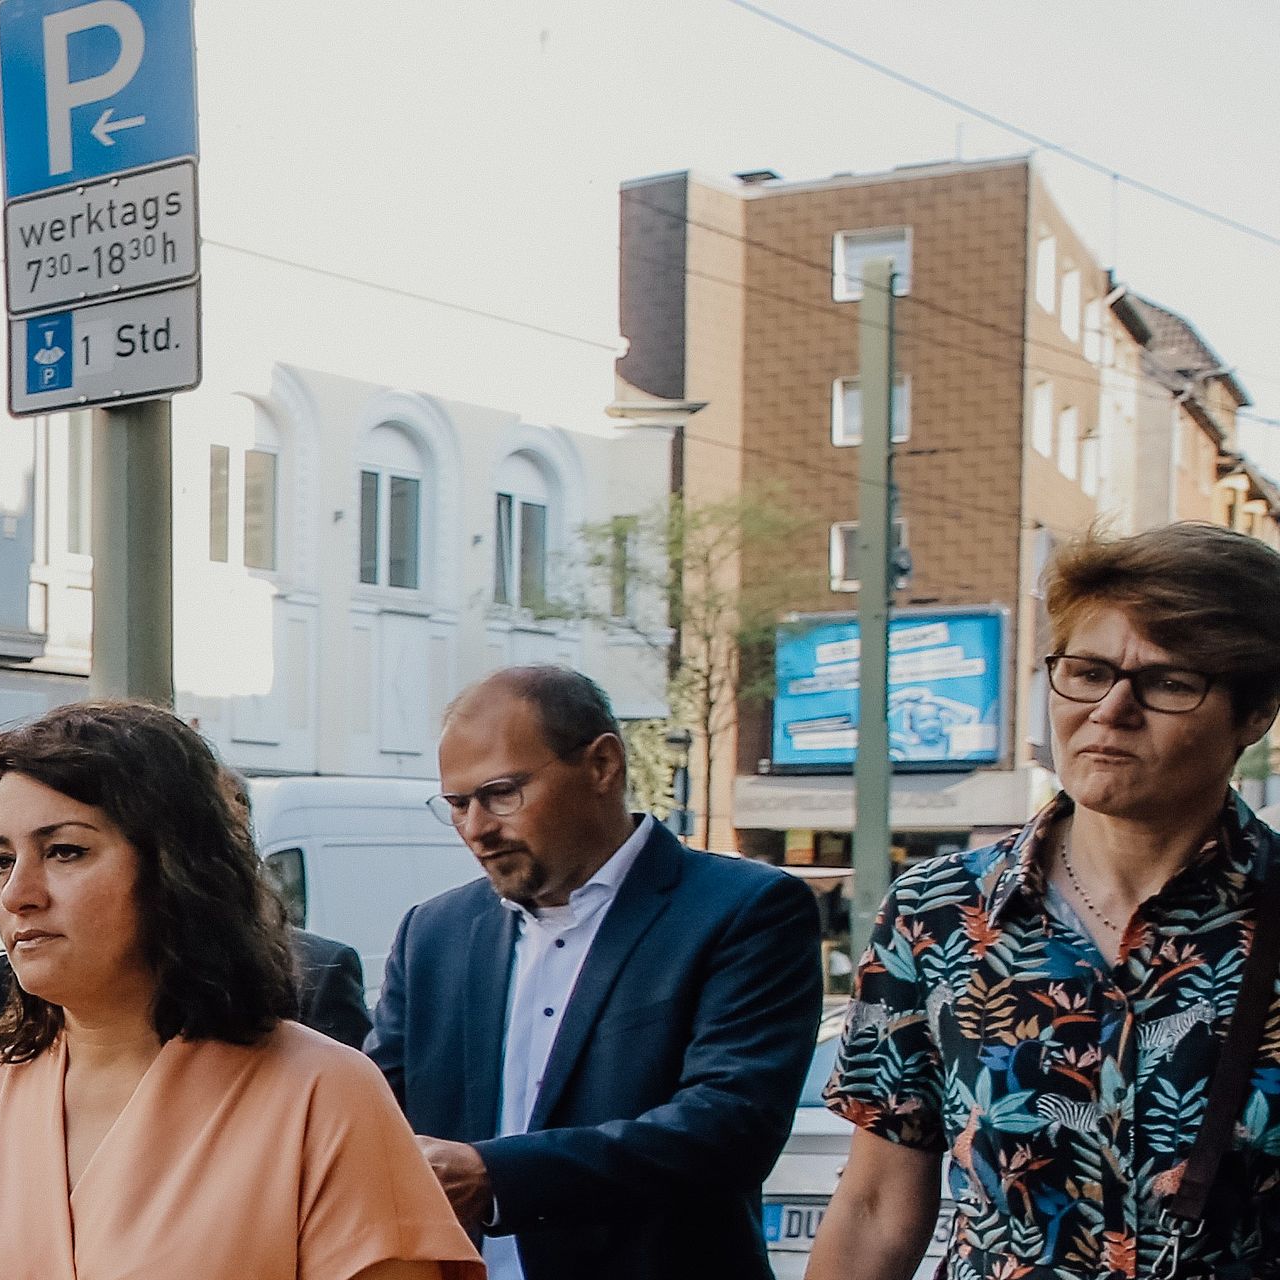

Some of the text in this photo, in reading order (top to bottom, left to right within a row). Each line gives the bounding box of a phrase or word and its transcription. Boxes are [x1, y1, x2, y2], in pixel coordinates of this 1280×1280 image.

[43, 0, 145, 176] P
[19, 191, 182, 249] werktags
[81, 316, 181, 366] 1 Std.
